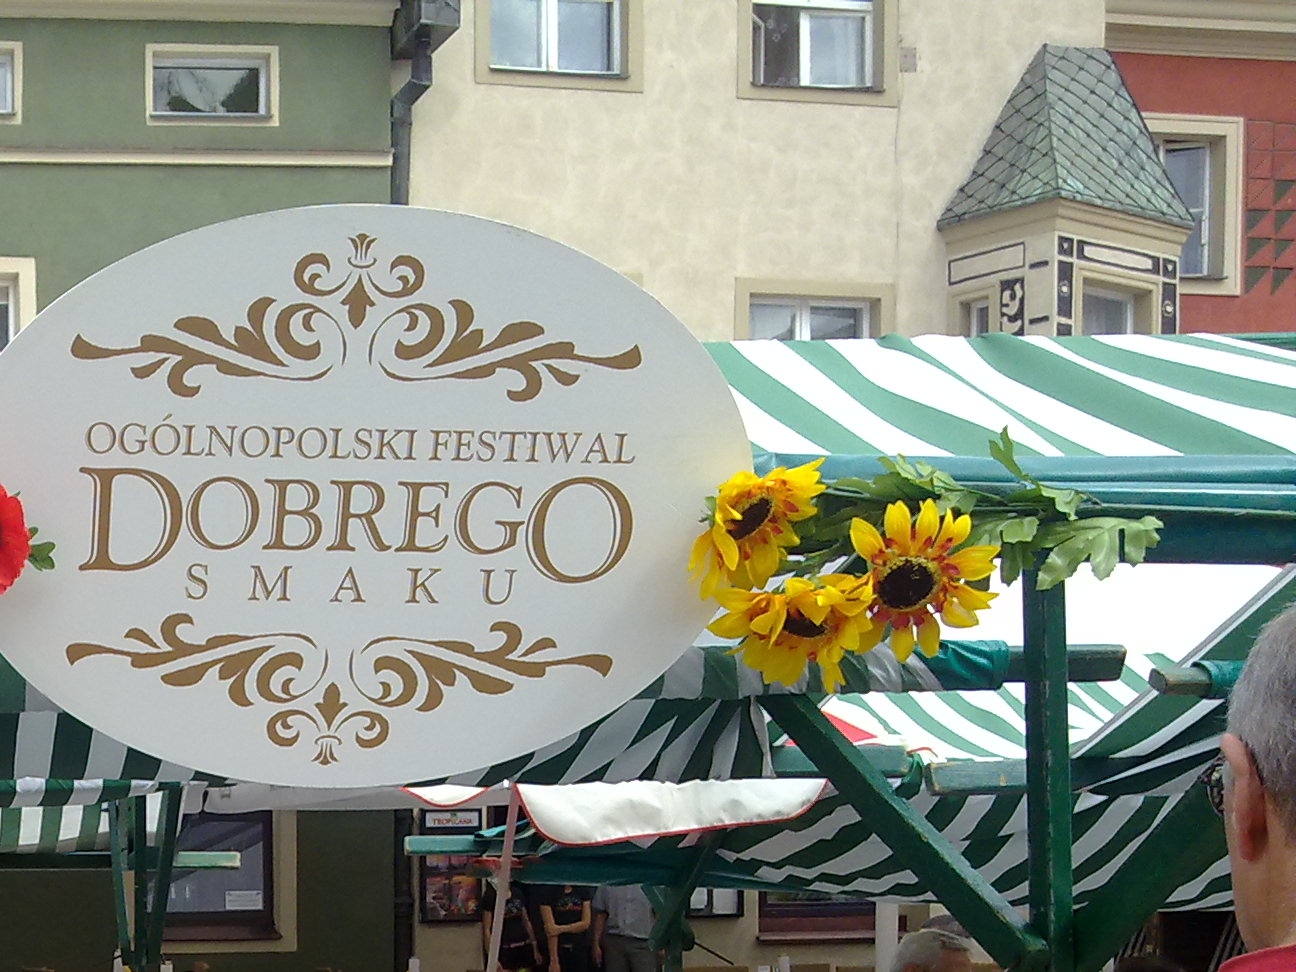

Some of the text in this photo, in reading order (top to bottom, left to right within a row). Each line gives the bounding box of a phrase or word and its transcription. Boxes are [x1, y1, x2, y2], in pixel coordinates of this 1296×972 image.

[84, 413, 636, 466] OGÓLNOPOLSKI FESTIWAL
[79, 466, 634, 584] DOBREGO
[184, 563, 519, 606] SMAKU
